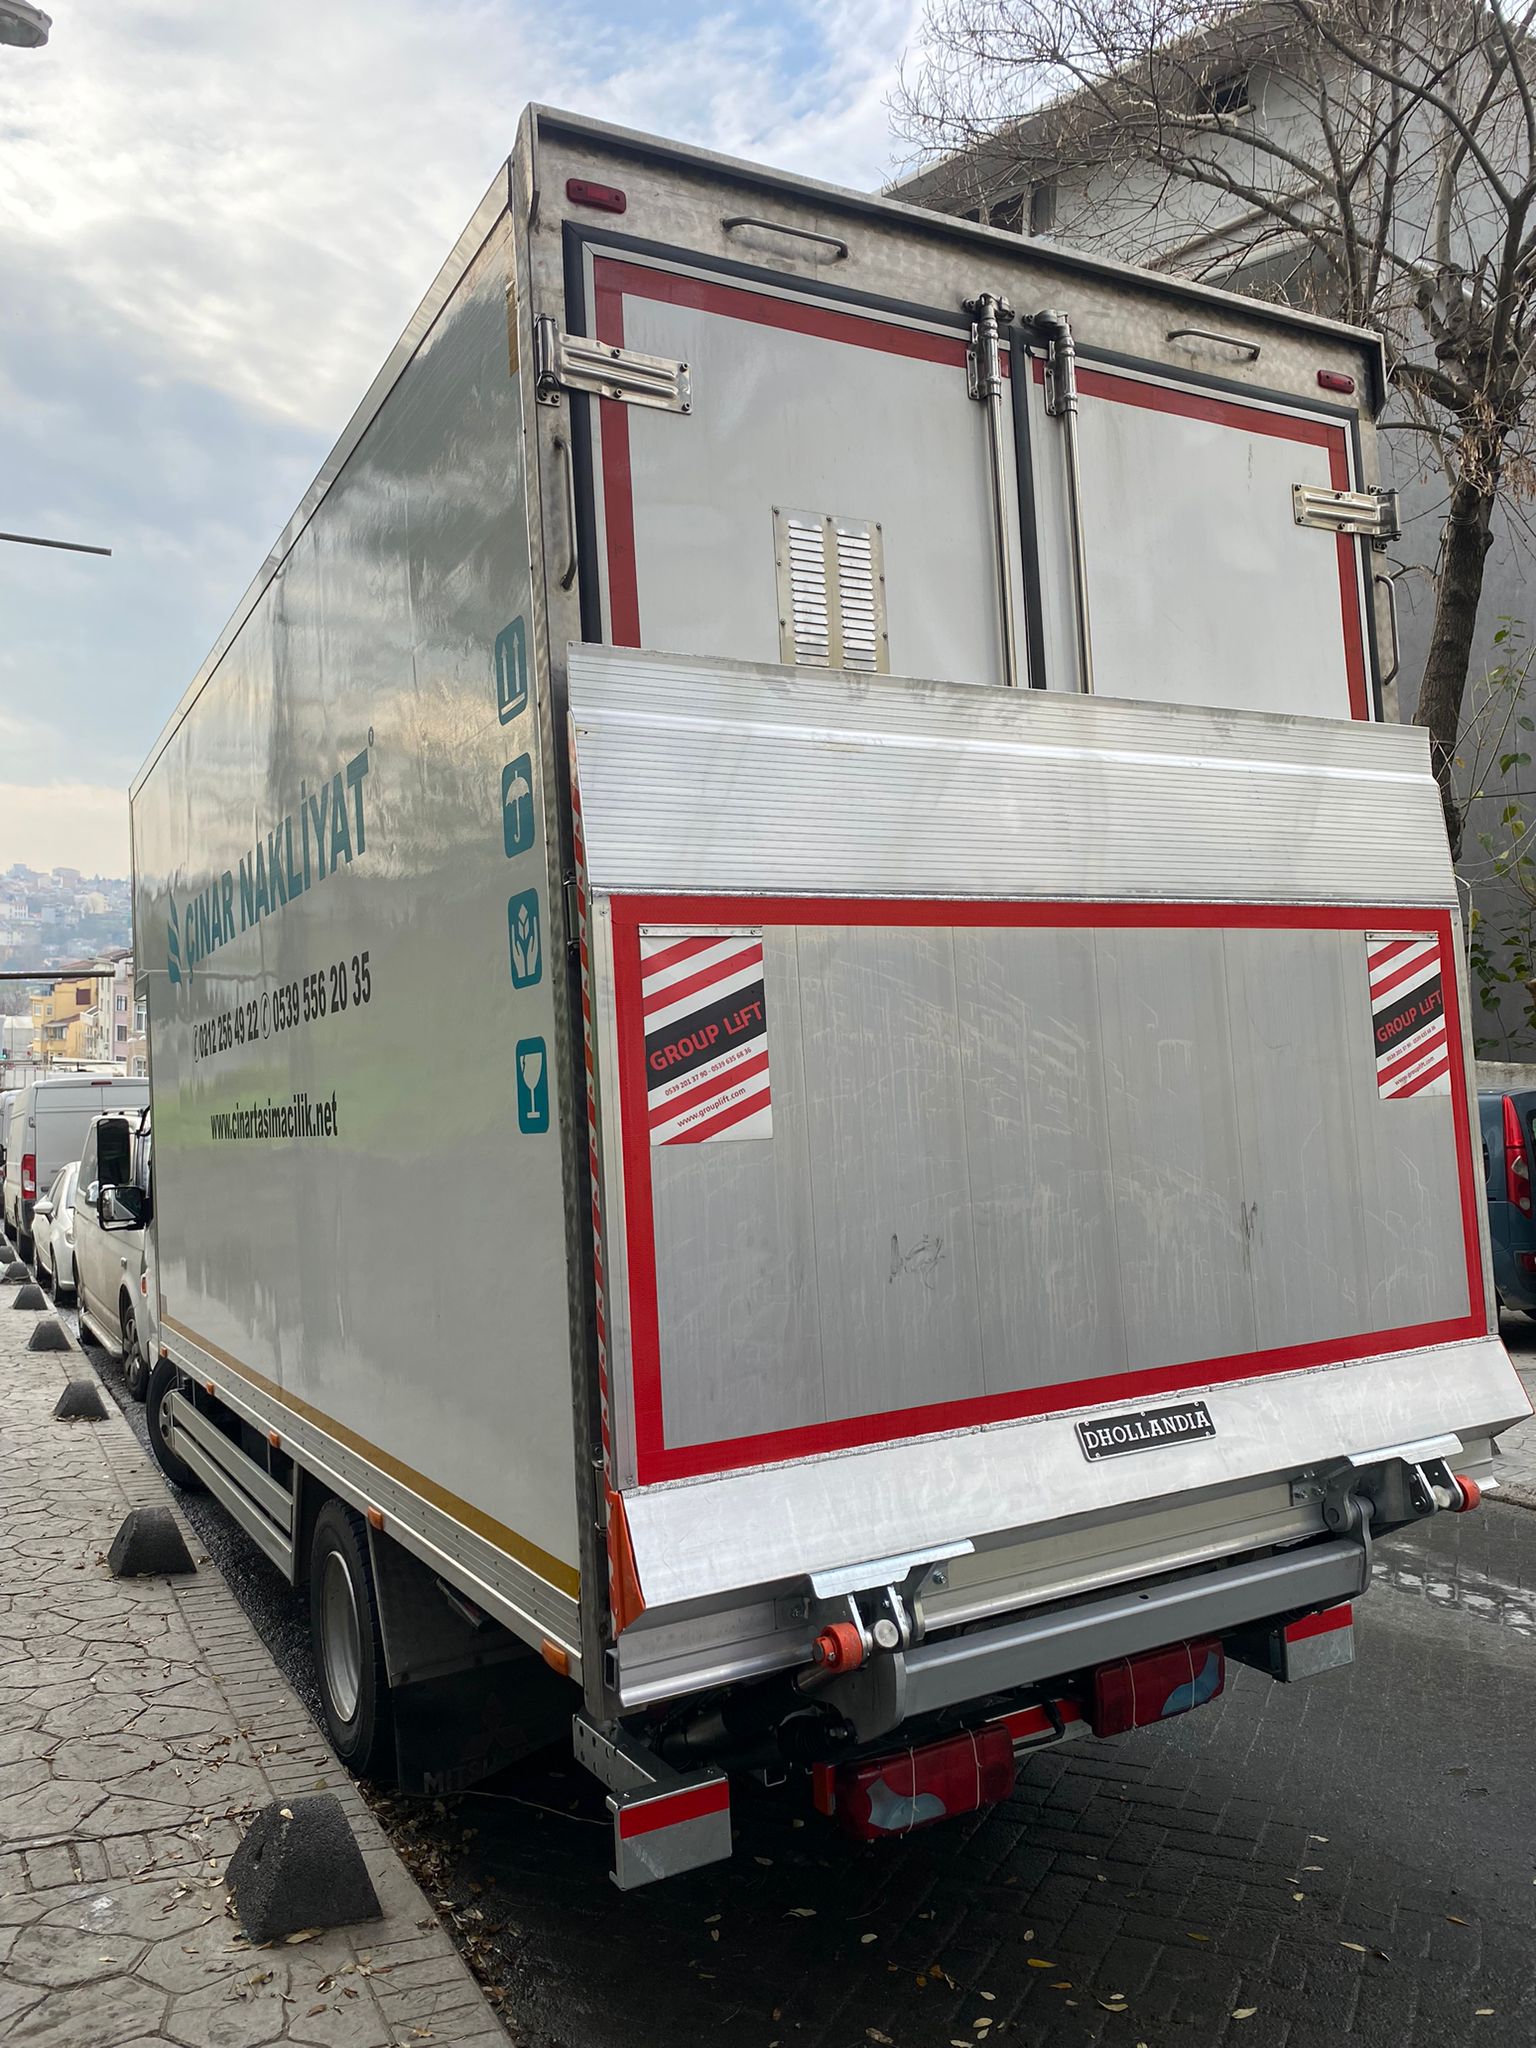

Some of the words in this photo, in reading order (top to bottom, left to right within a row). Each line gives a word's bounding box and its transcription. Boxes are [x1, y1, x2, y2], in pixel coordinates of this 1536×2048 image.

[185, 870, 236, 984] ÇINAR
[239, 748, 370, 933] NAKLİYAT
[199, 1019, 217, 1058] 0212
[217, 1012, 233, 1048] 256
[234, 1006, 245, 1045] 49
[246, 1000, 259, 1041] 22
[273, 982, 300, 1032] 0539
[303, 970, 326, 1022] 556
[330, 961, 348, 1013] 20
[352, 951, 371, 1006] 35
[1376, 1007, 1417, 1042] GROUP
[649, 1024, 720, 1071] GROUP
[664, 1085, 680, 1097] 0539
[680, 1079, 692, 1090] 201
[711, 1060, 726, 1072] 0539
[210, 1090, 338, 1140] www.cinartasimacilik.net
[677, 1087, 746, 1127] www.grouplift.com
[1083, 1410, 1212, 1449] DHOLLANDIA
